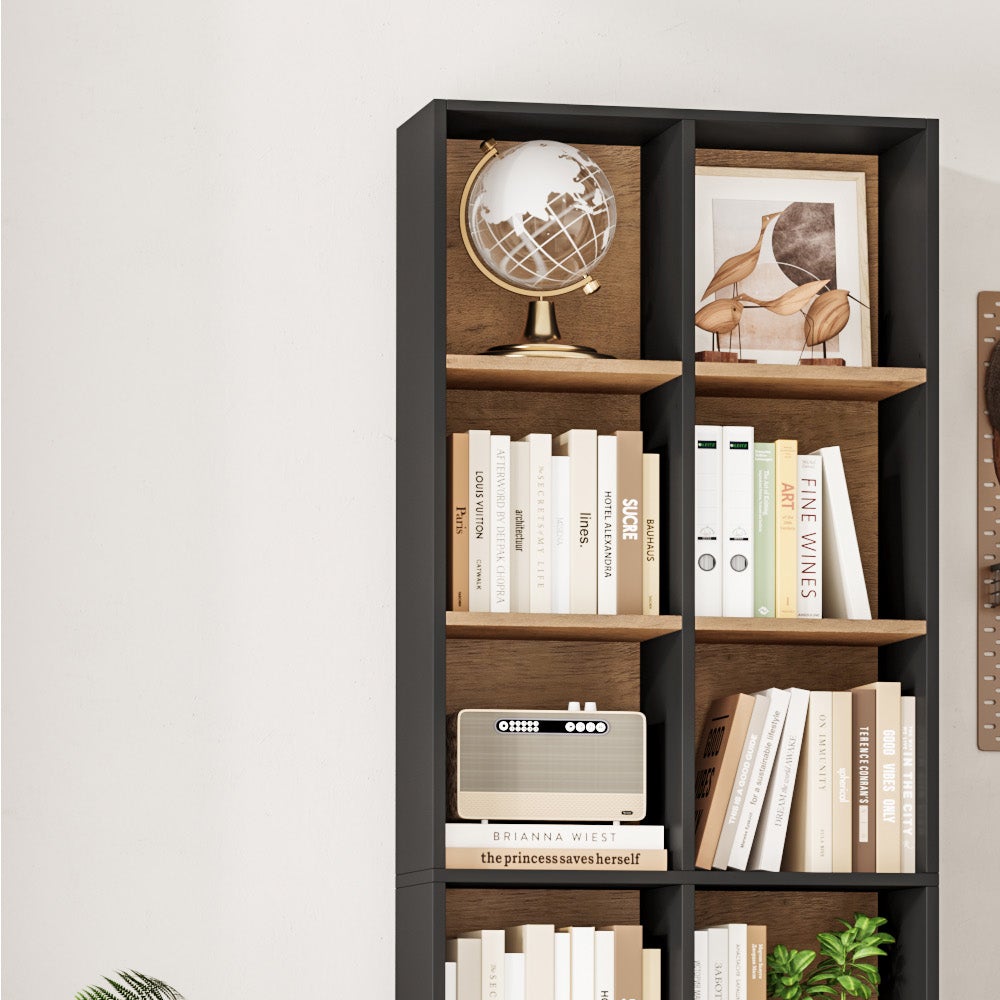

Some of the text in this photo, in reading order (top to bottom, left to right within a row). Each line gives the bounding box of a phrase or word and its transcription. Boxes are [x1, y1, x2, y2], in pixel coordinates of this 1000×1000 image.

[456, 506, 466, 535] Paris
[475, 471, 484, 539] LOUIS VUITTON
[496, 448, 506, 604] AFTERWORD BY DEEPAK CHOPRA
[579, 512, 592, 548] lines.
[622, 498, 639, 541] SUCRE
[781, 482, 795, 511] ART
[801, 478, 817, 522] FINE
[514, 509, 525, 552] architectuur
[537, 537, 544, 554] MY
[604, 491, 613, 578] HOTEL ALEXANDRA
[646, 519, 655, 562] BAUHAUS
[801, 532, 817, 599] WINES
[729, 733, 757, 825] THIS IS A GOOD GUIDE
[750, 794, 758, 806] for
[756, 742, 772, 786] sustainable
[768, 710, 780, 741] lifestyle
[775, 794, 787, 827] DREAM
[785, 734, 797, 767] AWAKE
[818, 714, 826, 791] ON IMMUNITY
[836, 767, 849, 803] spherical
[859, 726, 869, 804] TERENCE CONRAN'S
[882, 729, 896, 823] GOOD VIBES ONLY
[902, 751, 913, 836] IN THE CITY
[493, 831, 617, 842] BRIANNA WIEST
